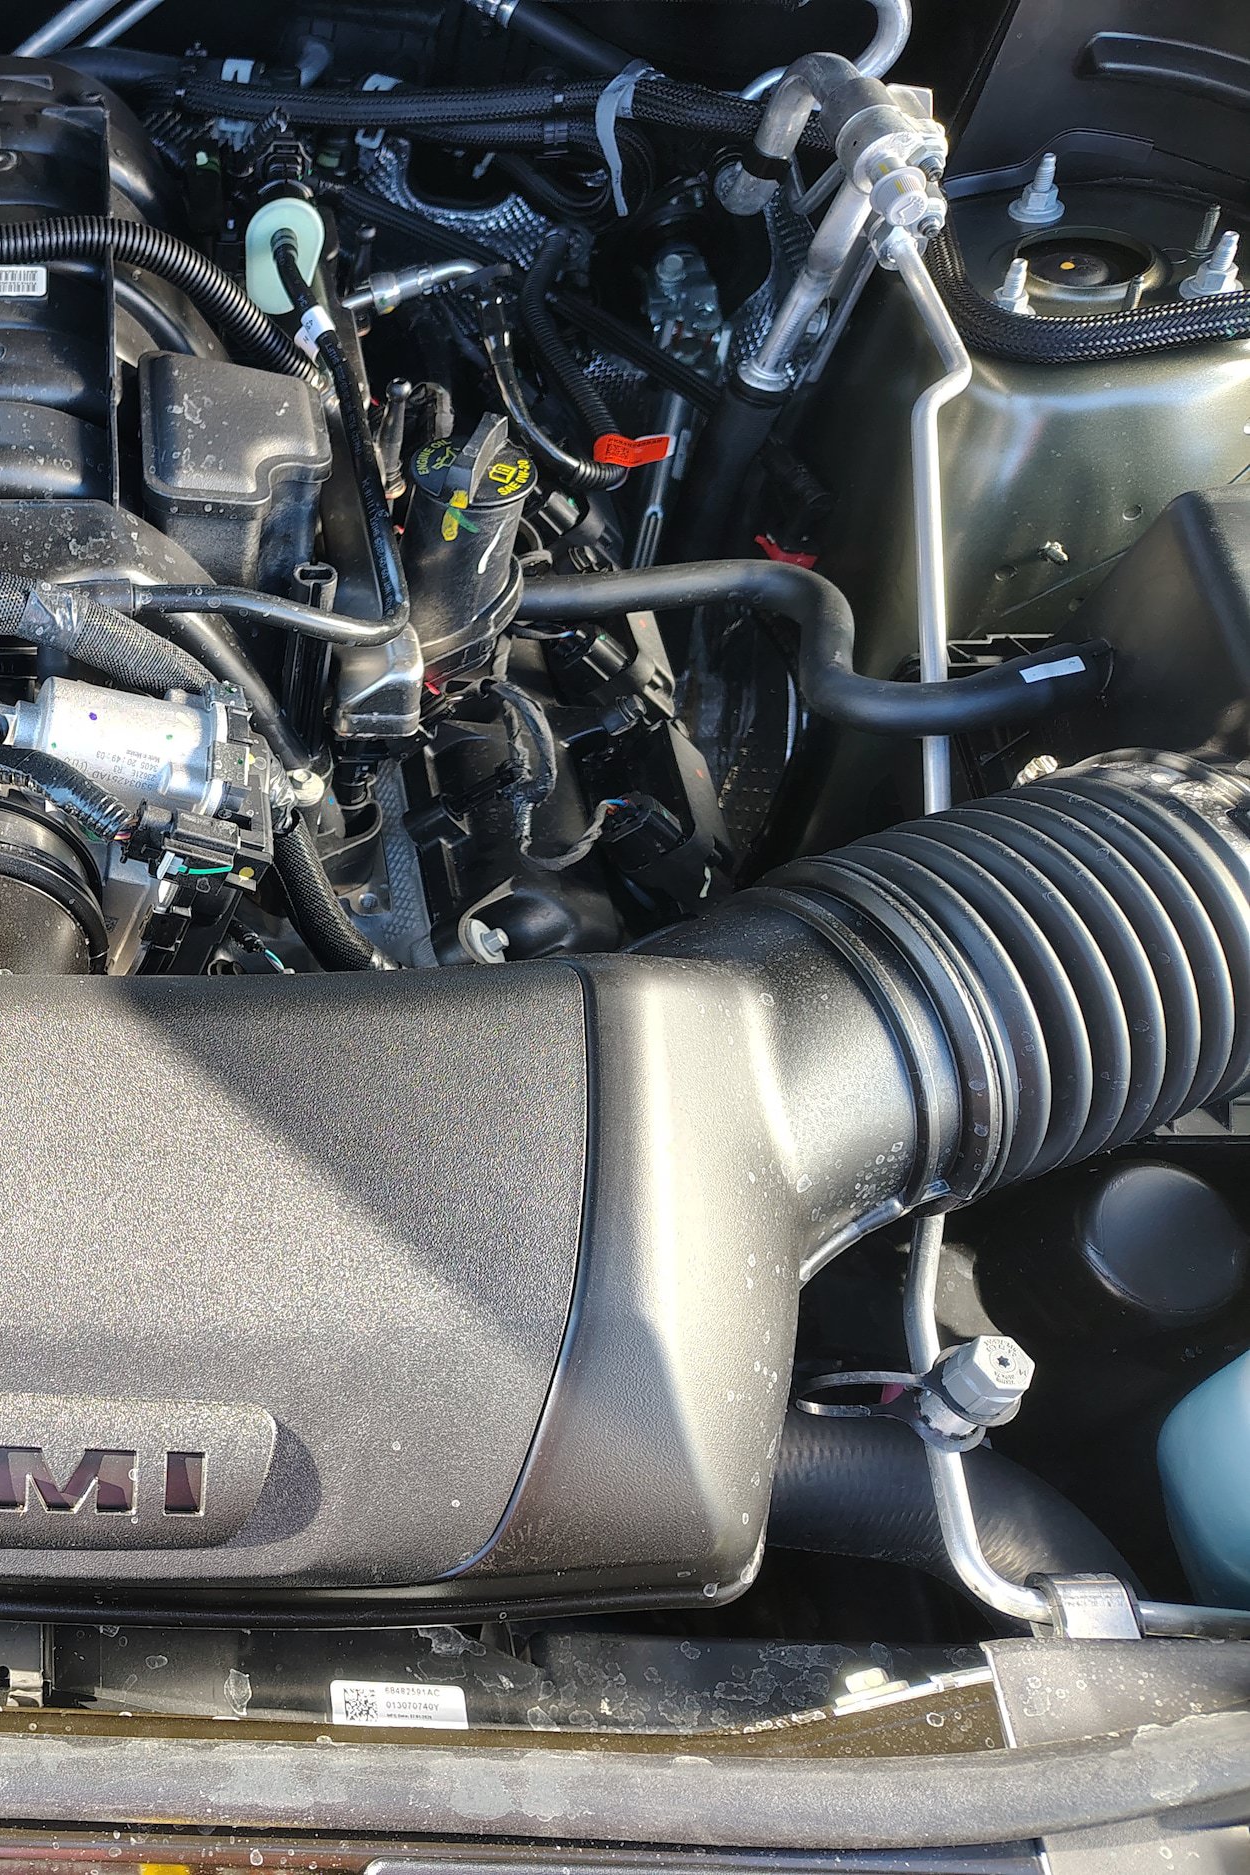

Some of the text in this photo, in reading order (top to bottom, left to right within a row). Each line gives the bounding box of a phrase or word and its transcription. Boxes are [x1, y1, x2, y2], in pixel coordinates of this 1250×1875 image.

[416, 438, 452, 476] ENGINE OIL
[497, 480, 522, 496] SAE
